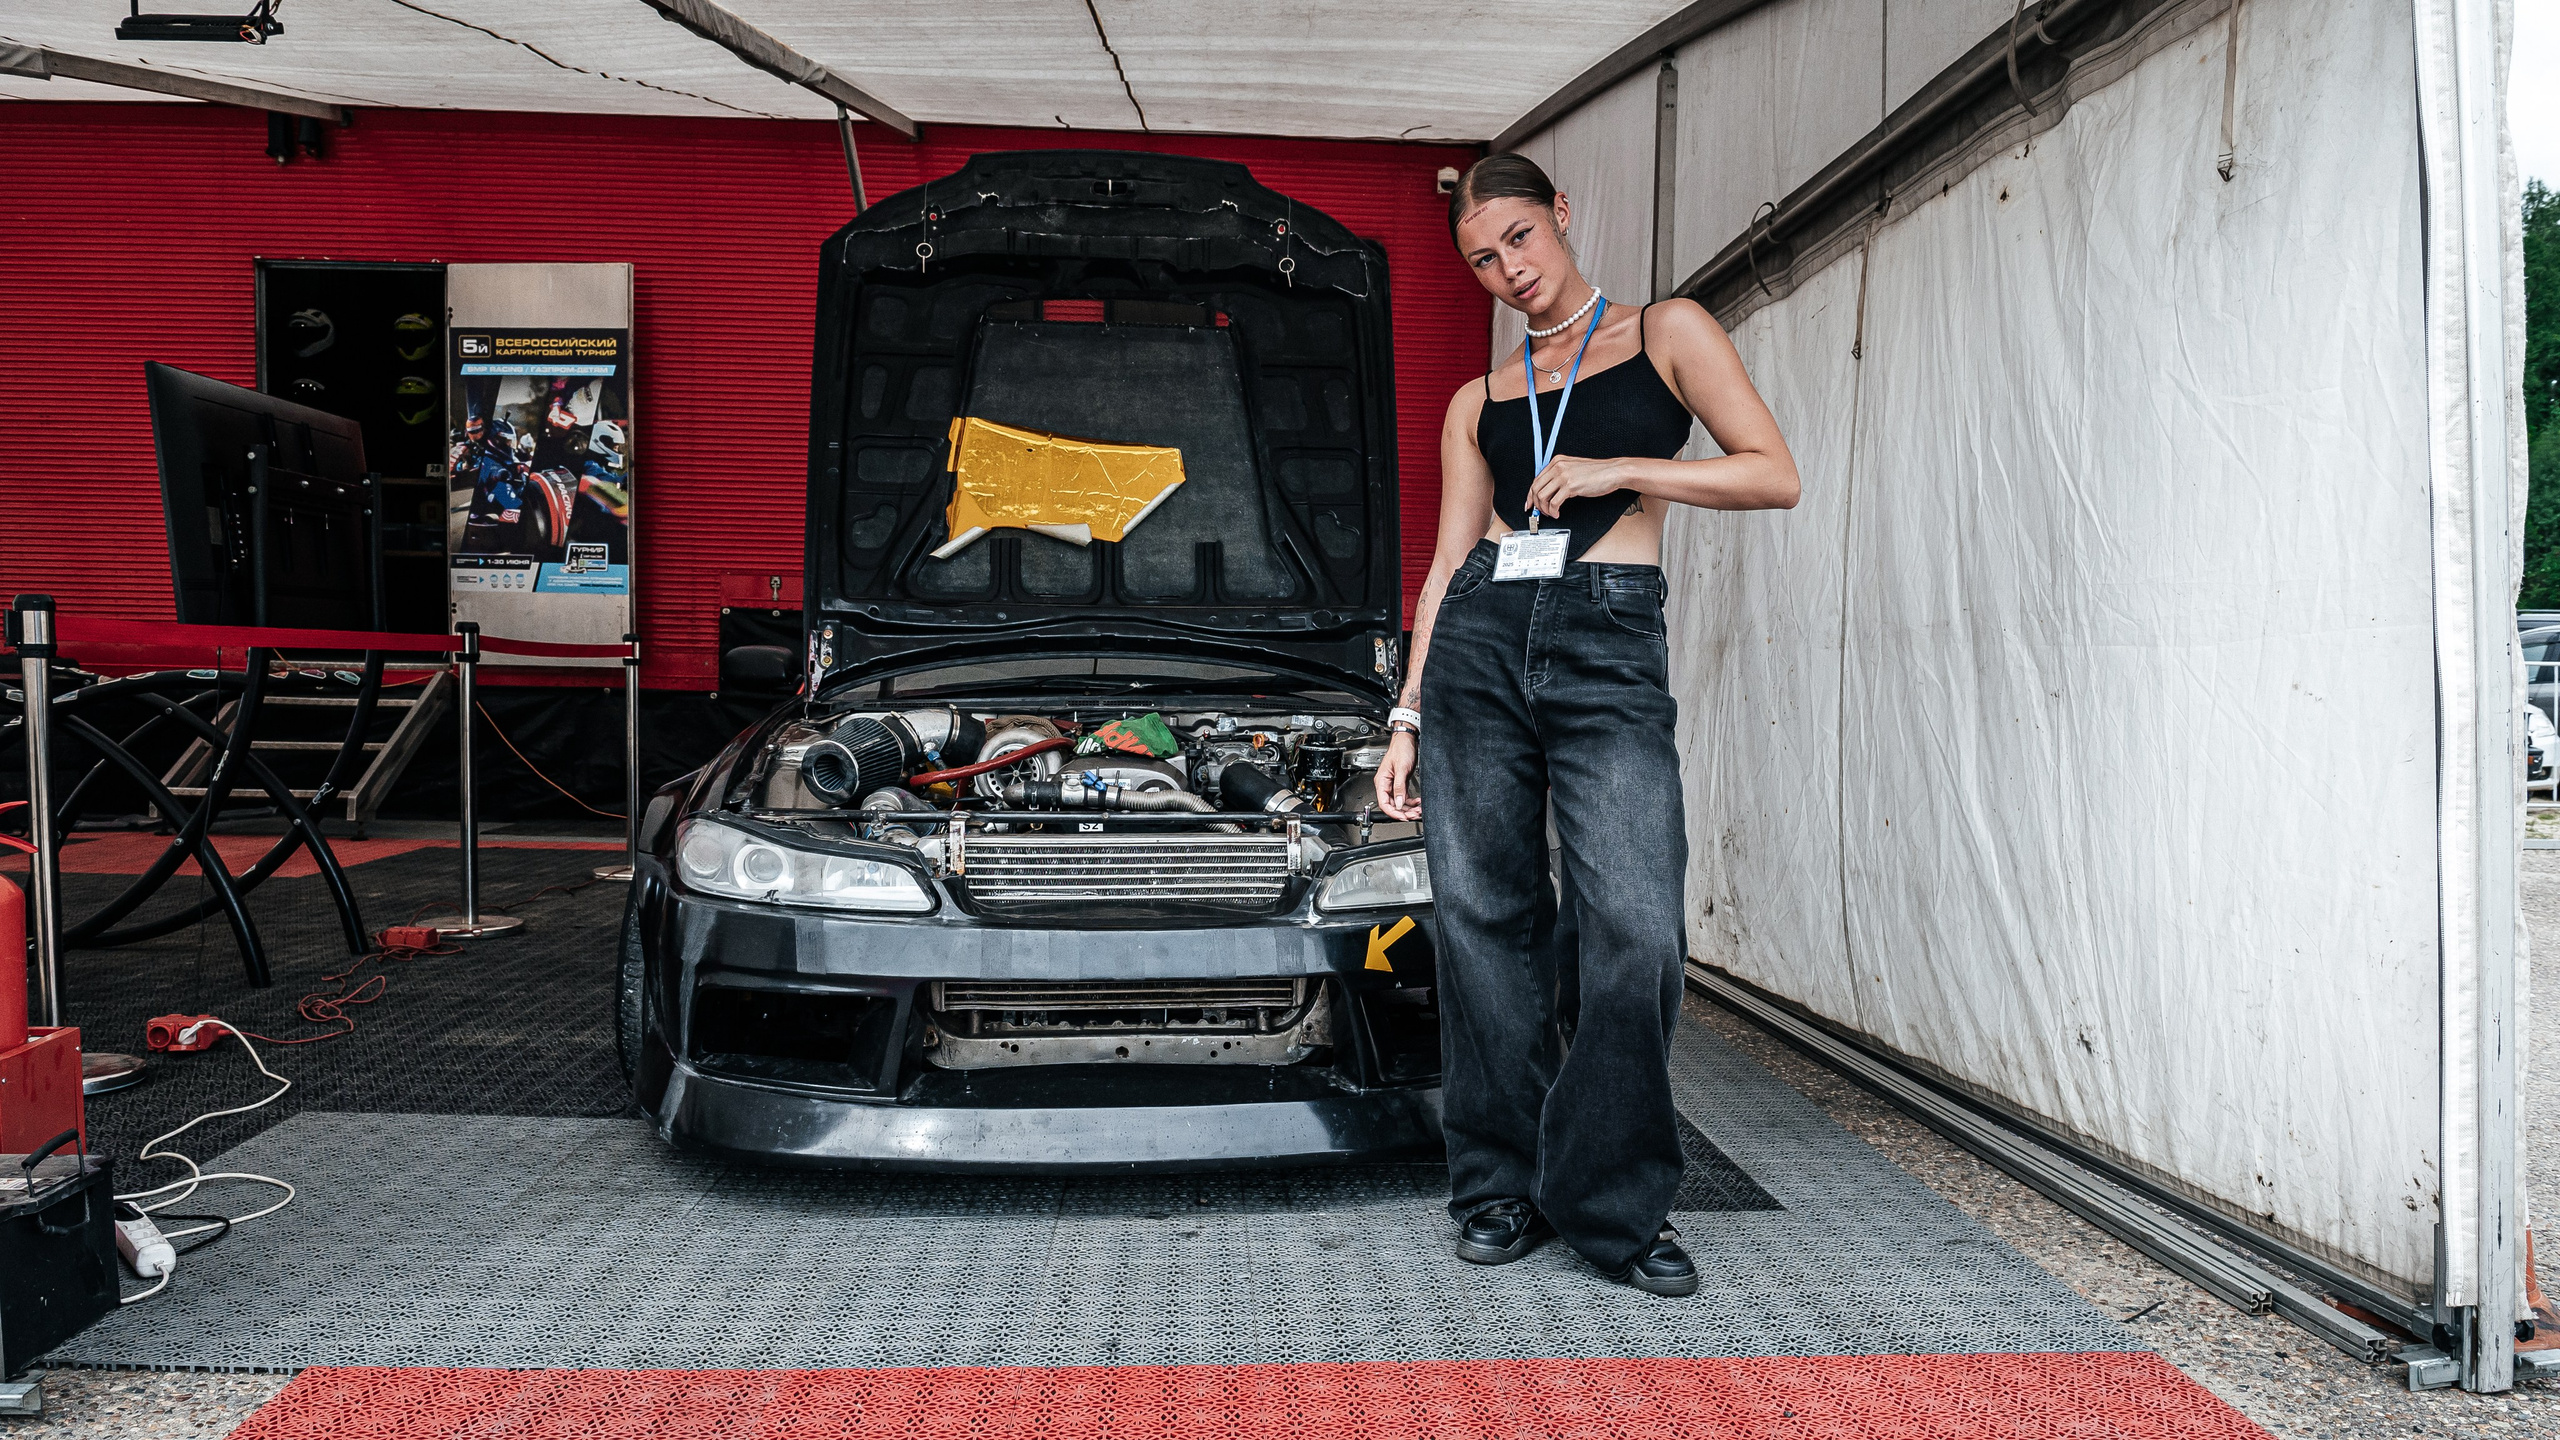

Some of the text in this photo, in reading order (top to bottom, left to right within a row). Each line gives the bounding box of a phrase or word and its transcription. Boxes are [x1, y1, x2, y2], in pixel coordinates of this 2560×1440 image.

[496, 337, 617, 347] ВСЕРОССИЙСКИЙ
[495, 348, 573, 356] КАРТИНГОВЫЙ
[557, 483, 572, 519] RACING
